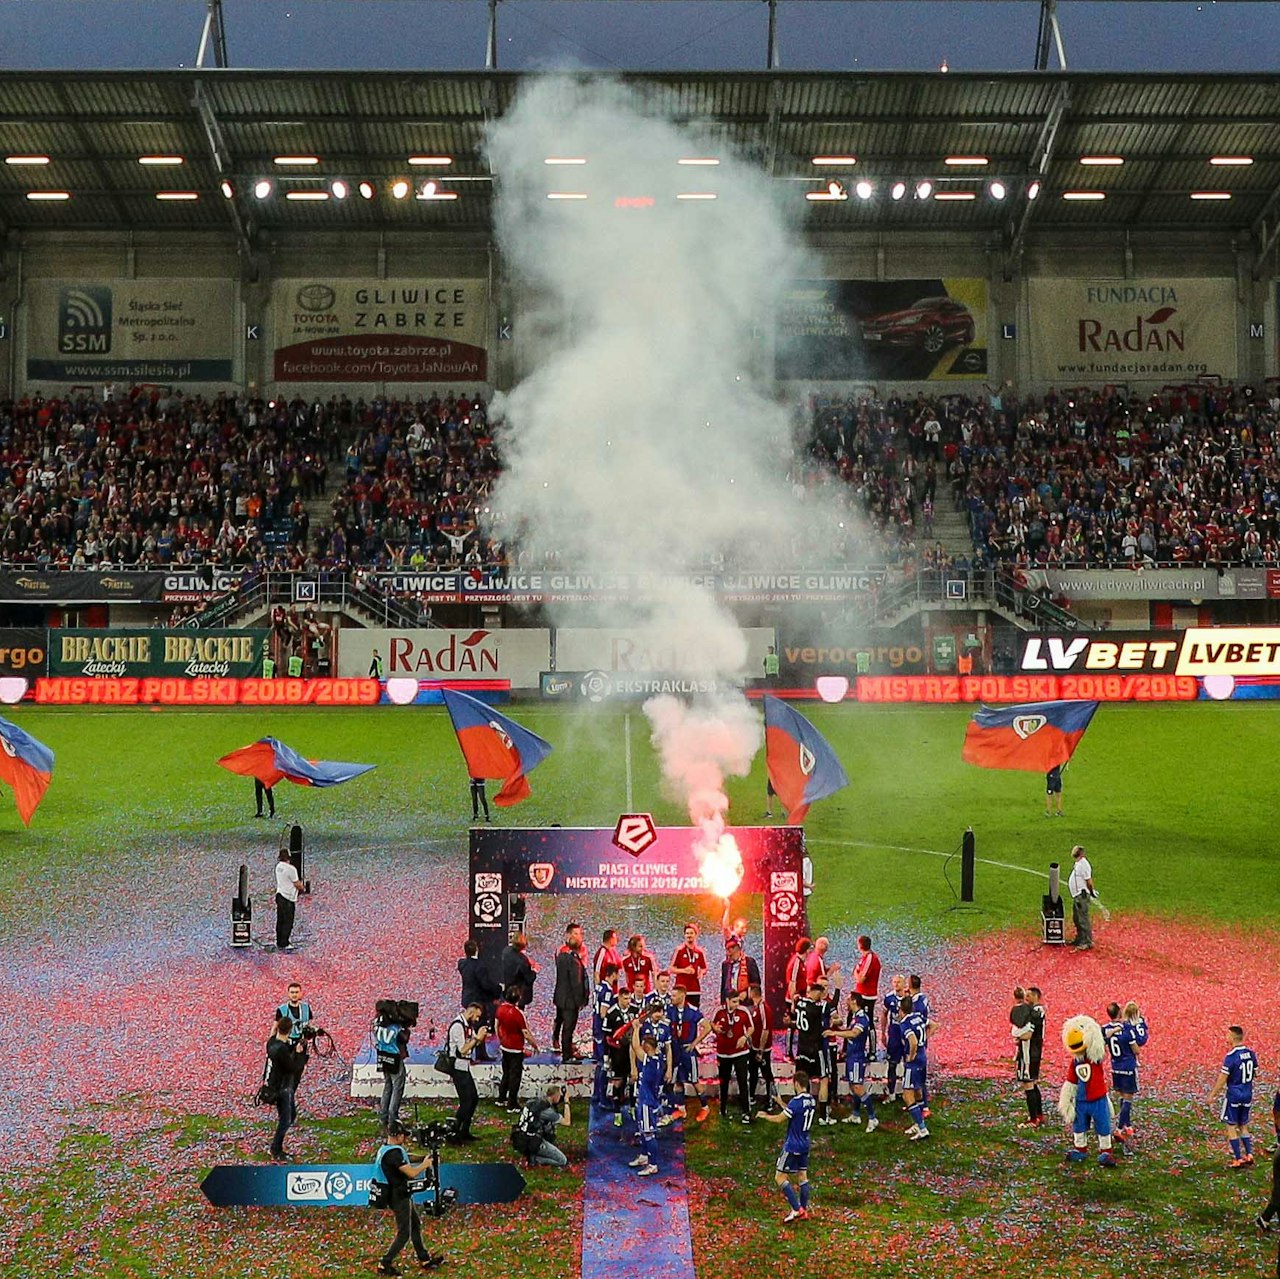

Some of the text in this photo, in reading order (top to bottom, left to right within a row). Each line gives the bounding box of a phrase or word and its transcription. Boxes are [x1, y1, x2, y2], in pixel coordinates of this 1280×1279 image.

[355, 289, 464, 304] GLIWICE
[1087, 287, 1178, 304] FUNDACJA
[118, 317, 195, 327] Metropolitalna
[293, 314, 339, 324] TOYOTA
[355, 313, 464, 327] ZABRZE
[247, 326, 258, 339] K
[500, 326, 510, 339] K
[1004, 326, 1012, 338] L
[1250, 325, 1263, 337] M
[63, 333, 107, 351] SSM
[312, 344, 452, 359] www.toyota.zabrze.pl
[65, 363, 191, 376] www.ssm.silesia.pl
[283, 361, 478, 376] facebook.com/ToyotaJaNowAn
[1058, 362, 1207, 375] www.fundacjaradan.org
[301, 586, 310, 596] K
[953, 583, 960, 594] L
[464, 594, 511, 602] PRZYSZŁOŚĆ
[61, 636, 151, 663] BRACKIE
[164, 636, 254, 663] BRACKIE
[81, 657, 127, 677] Žatecký
[184, 657, 230, 677] Žatecký
[38, 680, 377, 701] MISTRZ POLSKI 2018/2019
[616, 680, 717, 693] EKSTRAKLASA
[860, 676, 1194, 702] MISTRZ POLSKI 2018/2019
[599, 863, 678, 876] PIAST GLIWICE
[566, 877, 607, 889] MISTRZ
[610, 877, 649, 889] POLSKI
[1135, 1024, 1144, 1037] 6
[1110, 1036, 1121, 1057] 6
[1239, 1060, 1254, 1084] 19
[803, 1108, 815, 1131] 11
[297, 1180, 316, 1192] LOTTO
